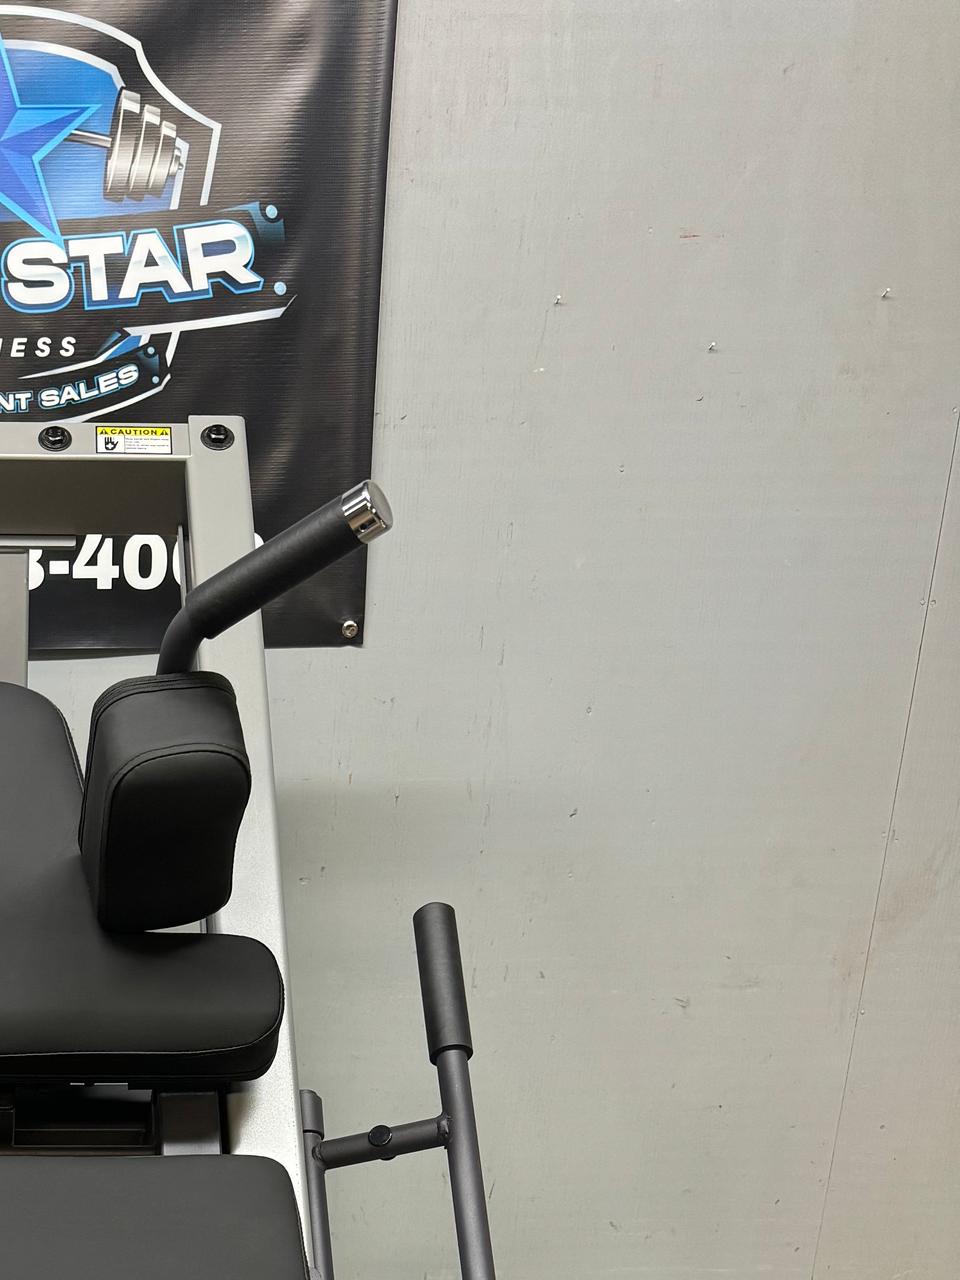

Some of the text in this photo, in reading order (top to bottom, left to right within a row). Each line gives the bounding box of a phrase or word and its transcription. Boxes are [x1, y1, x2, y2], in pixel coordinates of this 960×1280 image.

[4, 220, 259, 308] STAR
[39, 363, 139, 406] SALES
[110, 428, 157, 436] CAUTION
